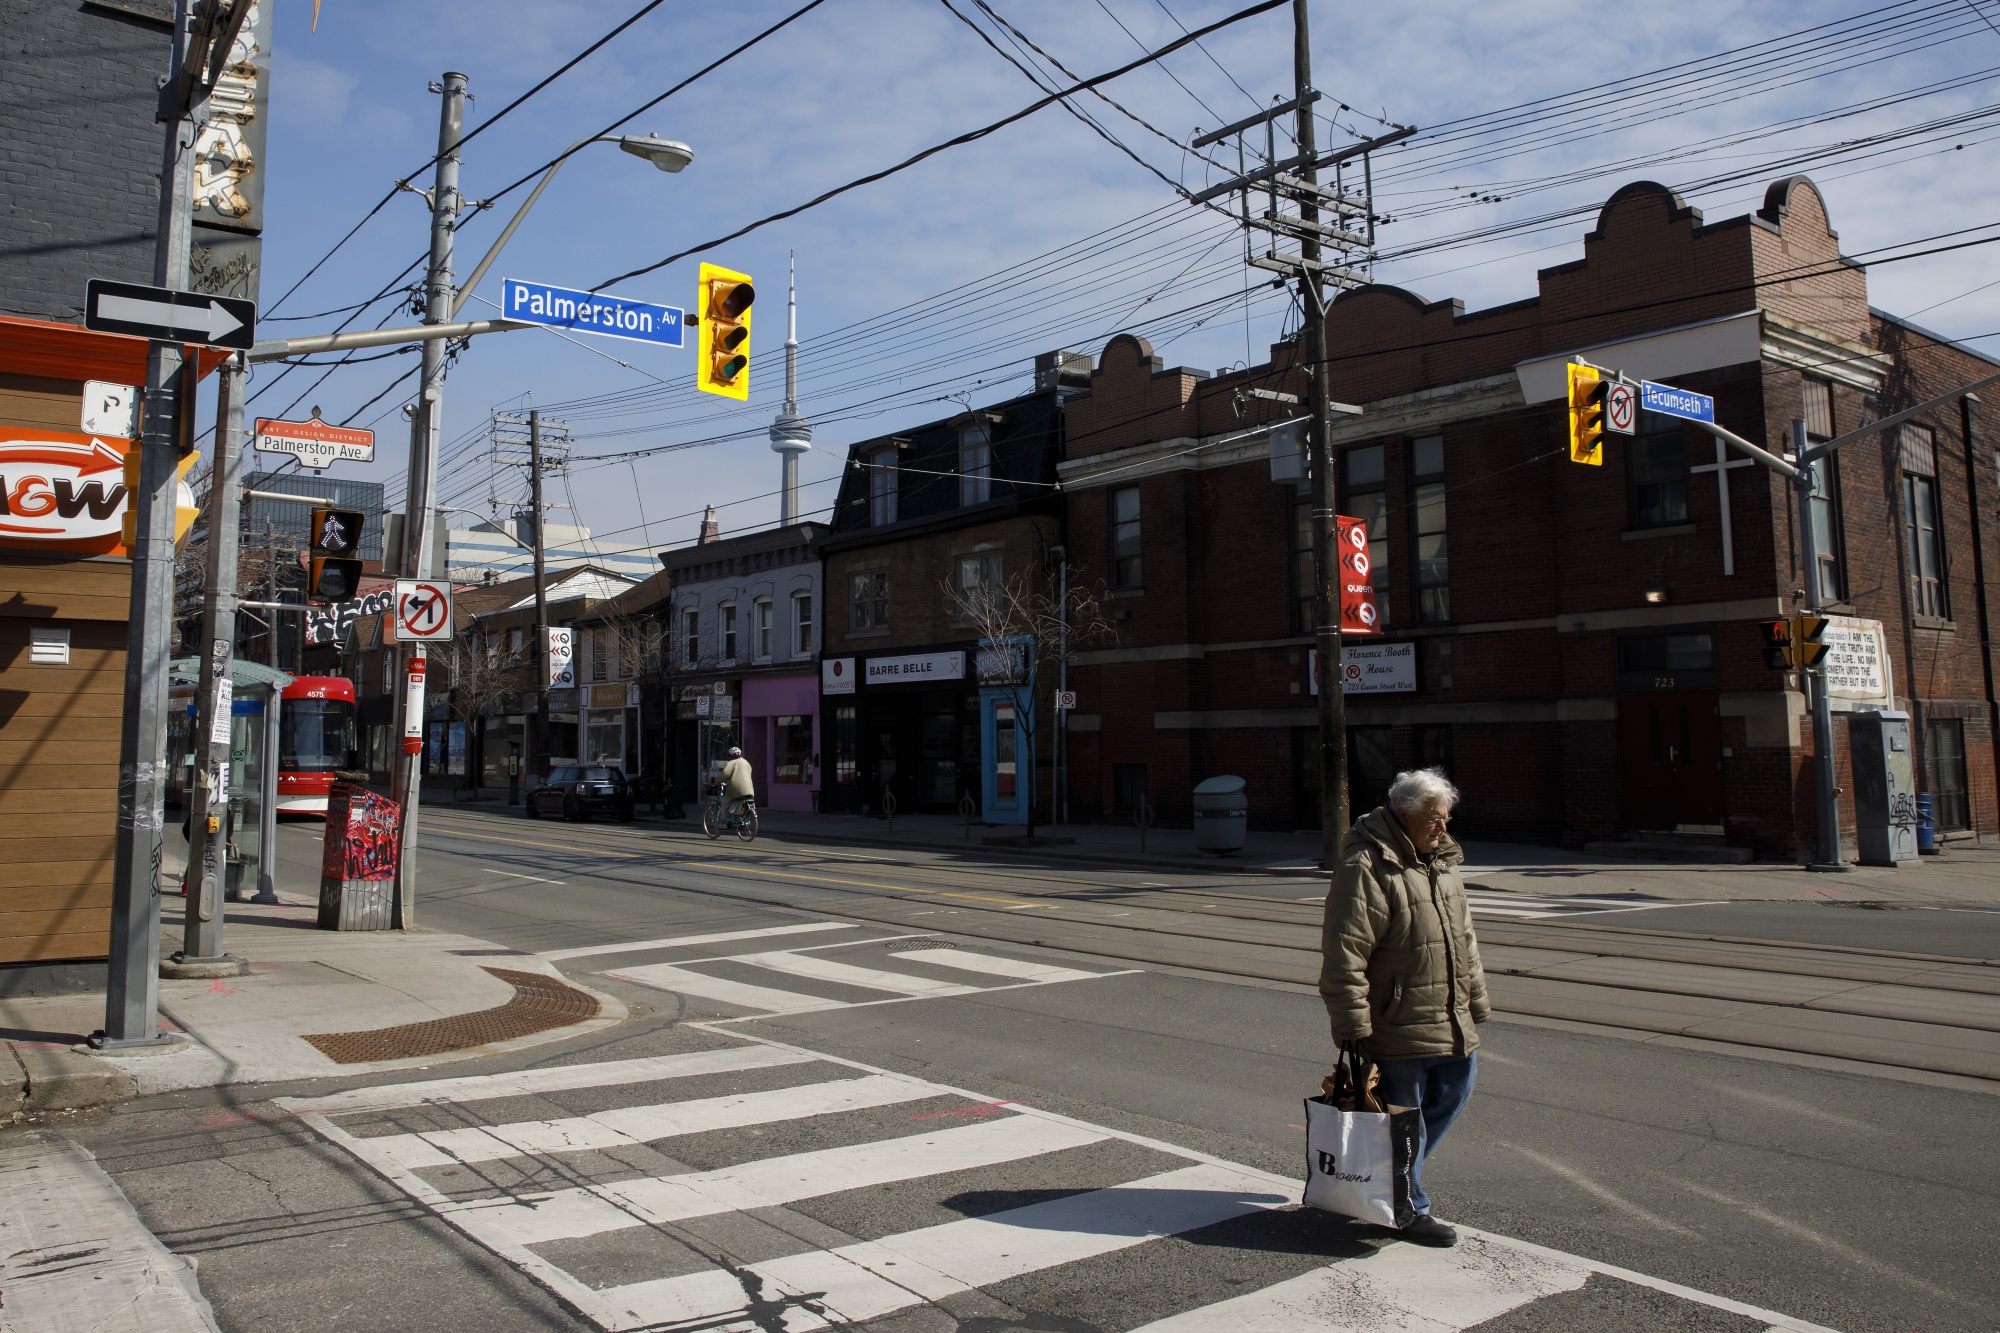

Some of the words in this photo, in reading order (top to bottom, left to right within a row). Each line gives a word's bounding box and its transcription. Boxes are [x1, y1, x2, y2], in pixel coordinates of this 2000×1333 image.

[514, 285, 653, 333] Palmerston
[662, 311, 677, 326] Av
[1645, 385, 1701, 414] Tecumseth
[1704, 399, 1710, 409] St
[294, 429, 325, 438] DESIGN
[329, 433, 368, 442] DISTRICT
[264, 436, 335, 456] Palmerston
[339, 444, 365, 459] Ave.
[0, 473, 128, 521] &W
[1852, 633, 1862, 642] AM
[1863, 634, 1874, 643] THE
[1347, 648, 1382, 659] Florence
[1385, 646, 1411, 657] Booth
[1836, 643, 1847, 652] THE
[1848, 643, 1863, 653] TRUTH
[1865, 645, 1876, 654] AND
[1830, 653, 1840, 663] THE
[1857, 655, 1865, 665] NO
[1865, 656, 1877, 665] MAN
[870, 665, 899, 675] BARRE
[903, 662, 933, 673] BELLE
[1365, 663, 1393, 674] House
[1826, 665, 1844, 674] OMETH
[1846, 666, 1859, 676] UNTO
[1861, 667, 1871, 676] THE
[1348, 683, 1359, 691] 723
[1360, 682, 1378, 691] Queen
[1379, 682, 1396, 690] Street
[1397, 681, 1413, 689] West
[1654, 678, 1675, 688] 723
[1829, 676, 1848, 686] FATHER
[1849, 678, 1859, 687] BUT
[1861, 678, 1868, 687] BY
[1316, 1149, 1372, 1183] Browns
